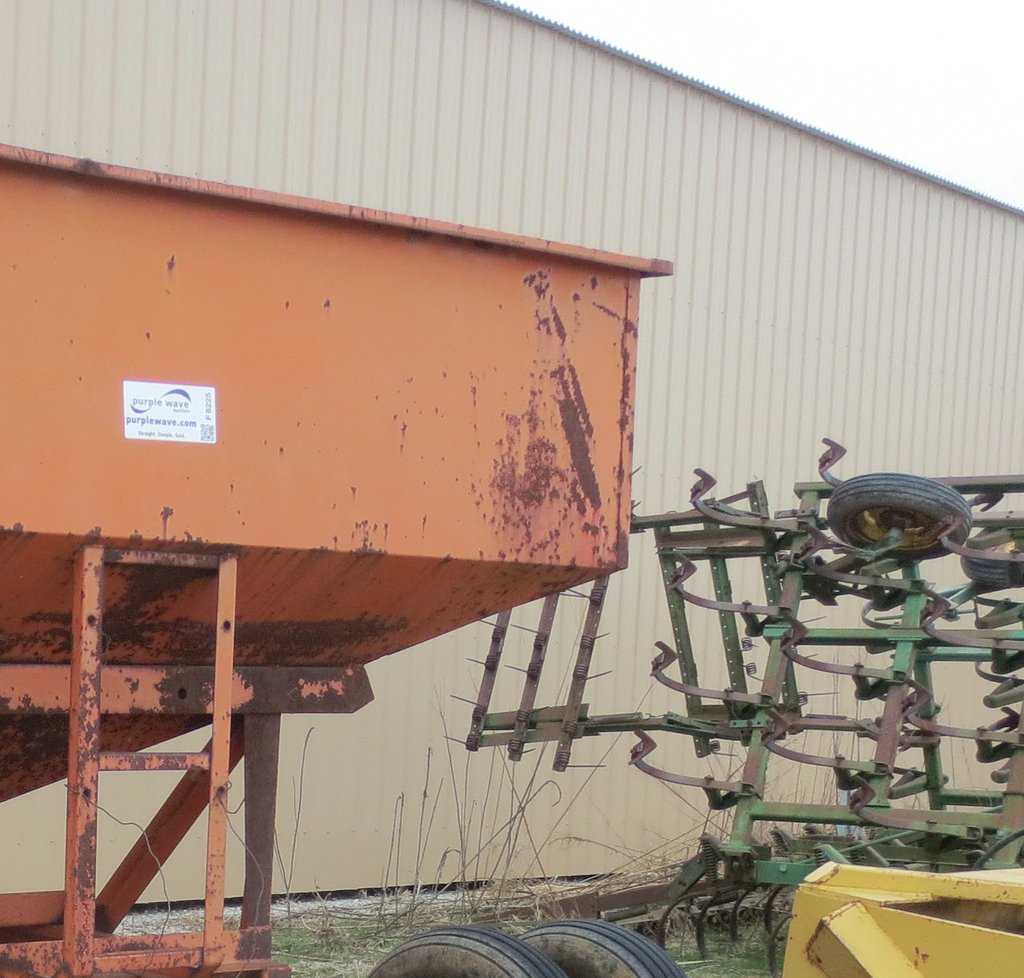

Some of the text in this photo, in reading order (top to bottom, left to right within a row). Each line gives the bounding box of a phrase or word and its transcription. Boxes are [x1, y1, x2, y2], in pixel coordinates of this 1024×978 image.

[132, 398, 189, 408] purple wave
[126, 416, 196, 427] purplewave.com
